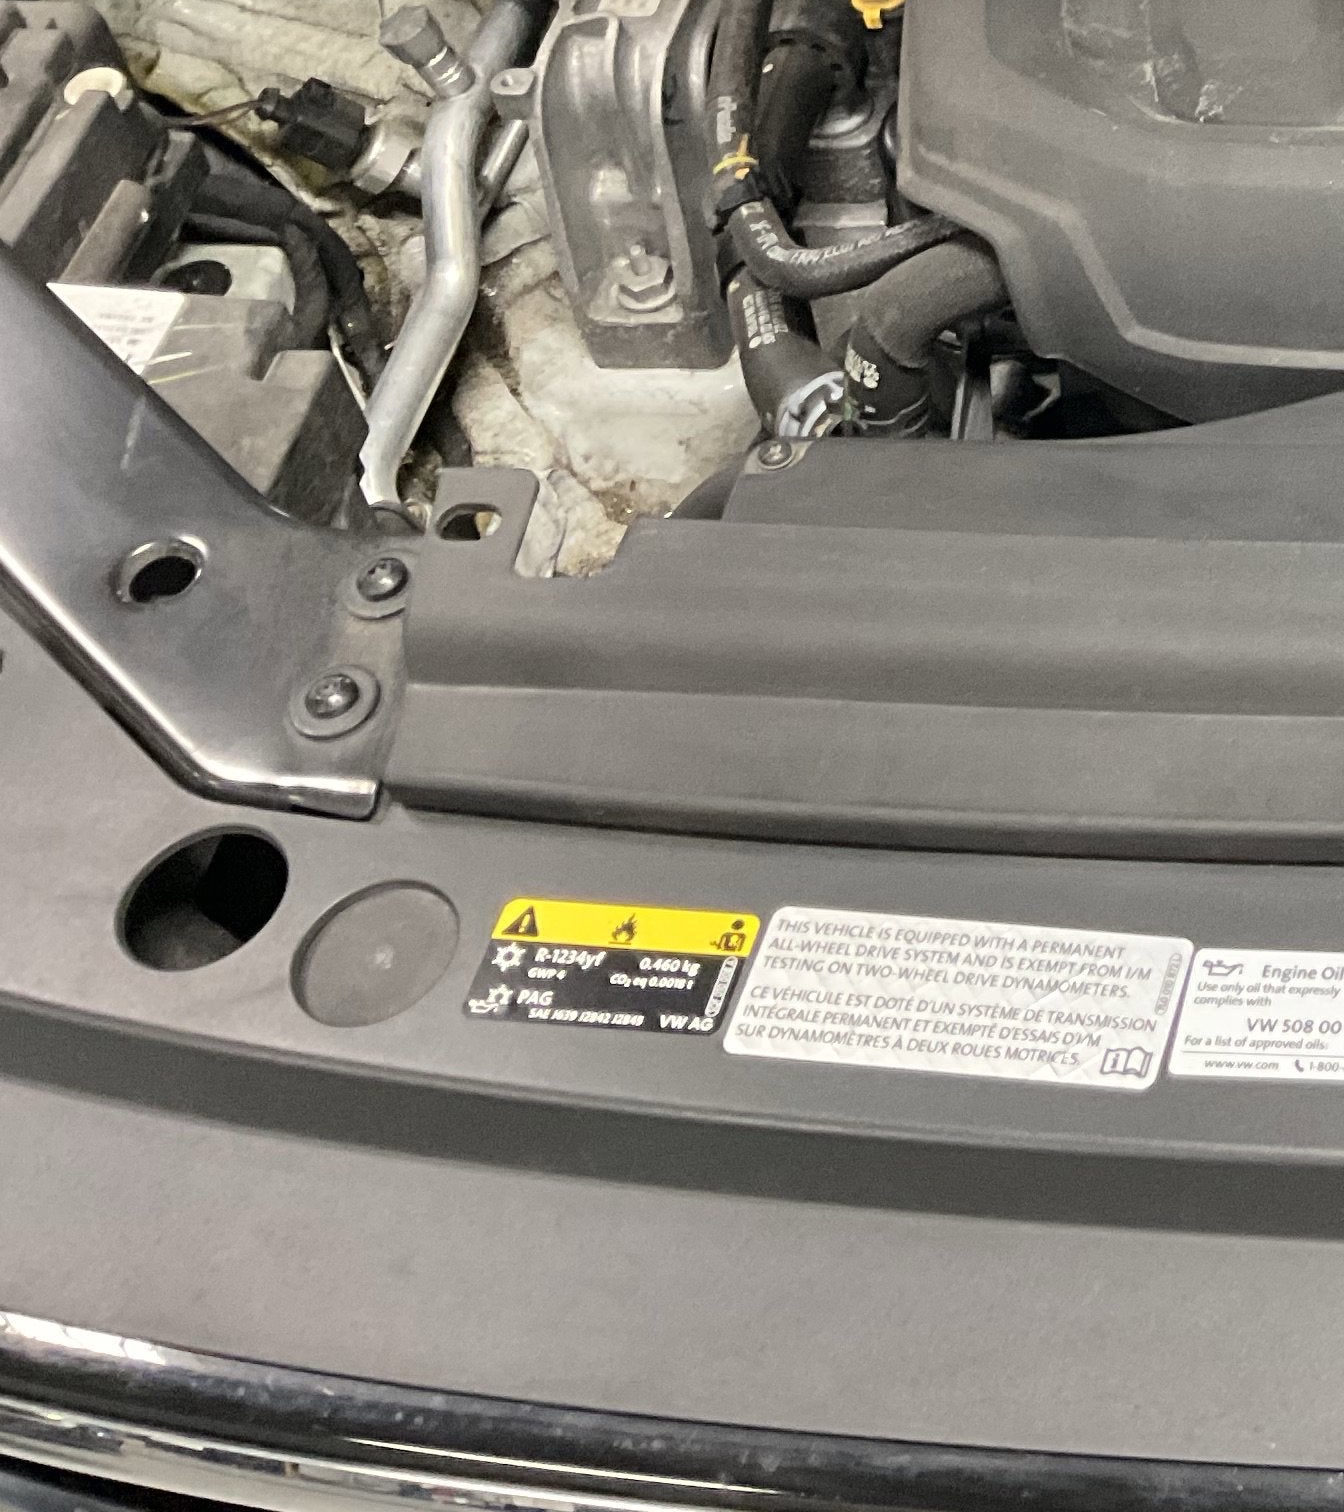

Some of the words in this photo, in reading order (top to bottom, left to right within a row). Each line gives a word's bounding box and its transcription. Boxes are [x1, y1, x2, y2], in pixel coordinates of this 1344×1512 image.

[776, 919, 810, 933] THIS
[814, 921, 874, 938] VEHICLE
[878, 926, 891, 938] IS
[894, 928, 970, 946] EQUIPPED
[973, 935, 1014, 951] WITH
[1016, 938, 1028, 951] A
[1031, 940, 1126, 959] PERMANENT
[534, 947, 607, 970] R-1234yf
[639, 957, 679, 972] 0.460
[681, 960, 701, 977] kg
[768, 937, 851, 956] ALL-WHEEL
[855, 944, 901, 960] DRIVE
[904, 947, 960, 964] SYSTEM
[962, 953, 997, 968] AND
[1000, 956, 1014, 968] IS
[1017, 958, 1077, 974] EXEMPT
[1080, 963, 1123, 977] FROM
[1127, 966, 1152, 980] I/M
[527, 967, 556, 979] GWP
[556, 969, 567, 980] 4
[762, 955, 825, 972] TESTING
[827, 961, 851, 975] ON
[856, 963, 950, 984] TWO-WHEEL
[952, 970, 999, 987] DRIVE
[1002, 976, 1131, 999] DYNAMOMETERS.
[1262, 964, 1317, 983] Engine
[1321, 966, 1344, 981] Oil
[632, 977, 648, 989] eq
[1197, 981, 1218, 992] Use
[1220, 982, 1245, 995] only
[1246, 982, 1260, 993] oil
[1262, 983, 1286, 994] that
[1288, 984, 1341, 999] expressly
[516, 989, 554, 1006] PAG
[1194, 995, 1243, 1008] complies
[1246, 996, 1272, 1007] with
[750, 986, 766, 999] CE
[772, 986, 843, 1005] VÉHICULE
[846, 993, 871, 1007] EST
[873, 994, 914, 1010] DOTÉ
[917, 999, 955, 1014] D'UN
[958, 1002, 1020, 1020] SYSTÈME
[1023, 1008, 1044, 1022] DE
[1047, 1011, 1158, 1032] TRANSMISSION
[659, 1014, 688, 1029] VW
[688, 1015, 714, 1032] AG
[742, 1004, 822, 1022] INTÉGRALE
[823, 1011, 911, 1030] PERMANENT
[913, 1018, 930, 1032] ET
[932, 1021, 996, 1039] EXEMPTÉ
[999, 1026, 1059, 1044] D'ESSAIS
[1247, 1017, 1278, 1033] VW
[1281, 1019, 1314, 1034] 508
[1318, 1020, 1343, 1035] 00
[735, 1024, 766, 1037] SUR
[768, 1026, 890, 1049] DYNAMOMÈTRES
[891, 1034, 903, 1050] À
[906, 1037, 949, 1054] DEUX
[951, 1042, 1002, 1059] ROUES
[1004, 1046, 1081, 1065] MOTRICES.
[1185, 1035, 1203, 1046] For
[1204, 1038, 1212, 1046] a
[1214, 1036, 1232, 1047] list
[1234, 1036, 1248, 1047] of
[1249, 1039, 1303, 1051] approved
[1204, 1060, 1280, 1071] www.vw.com
